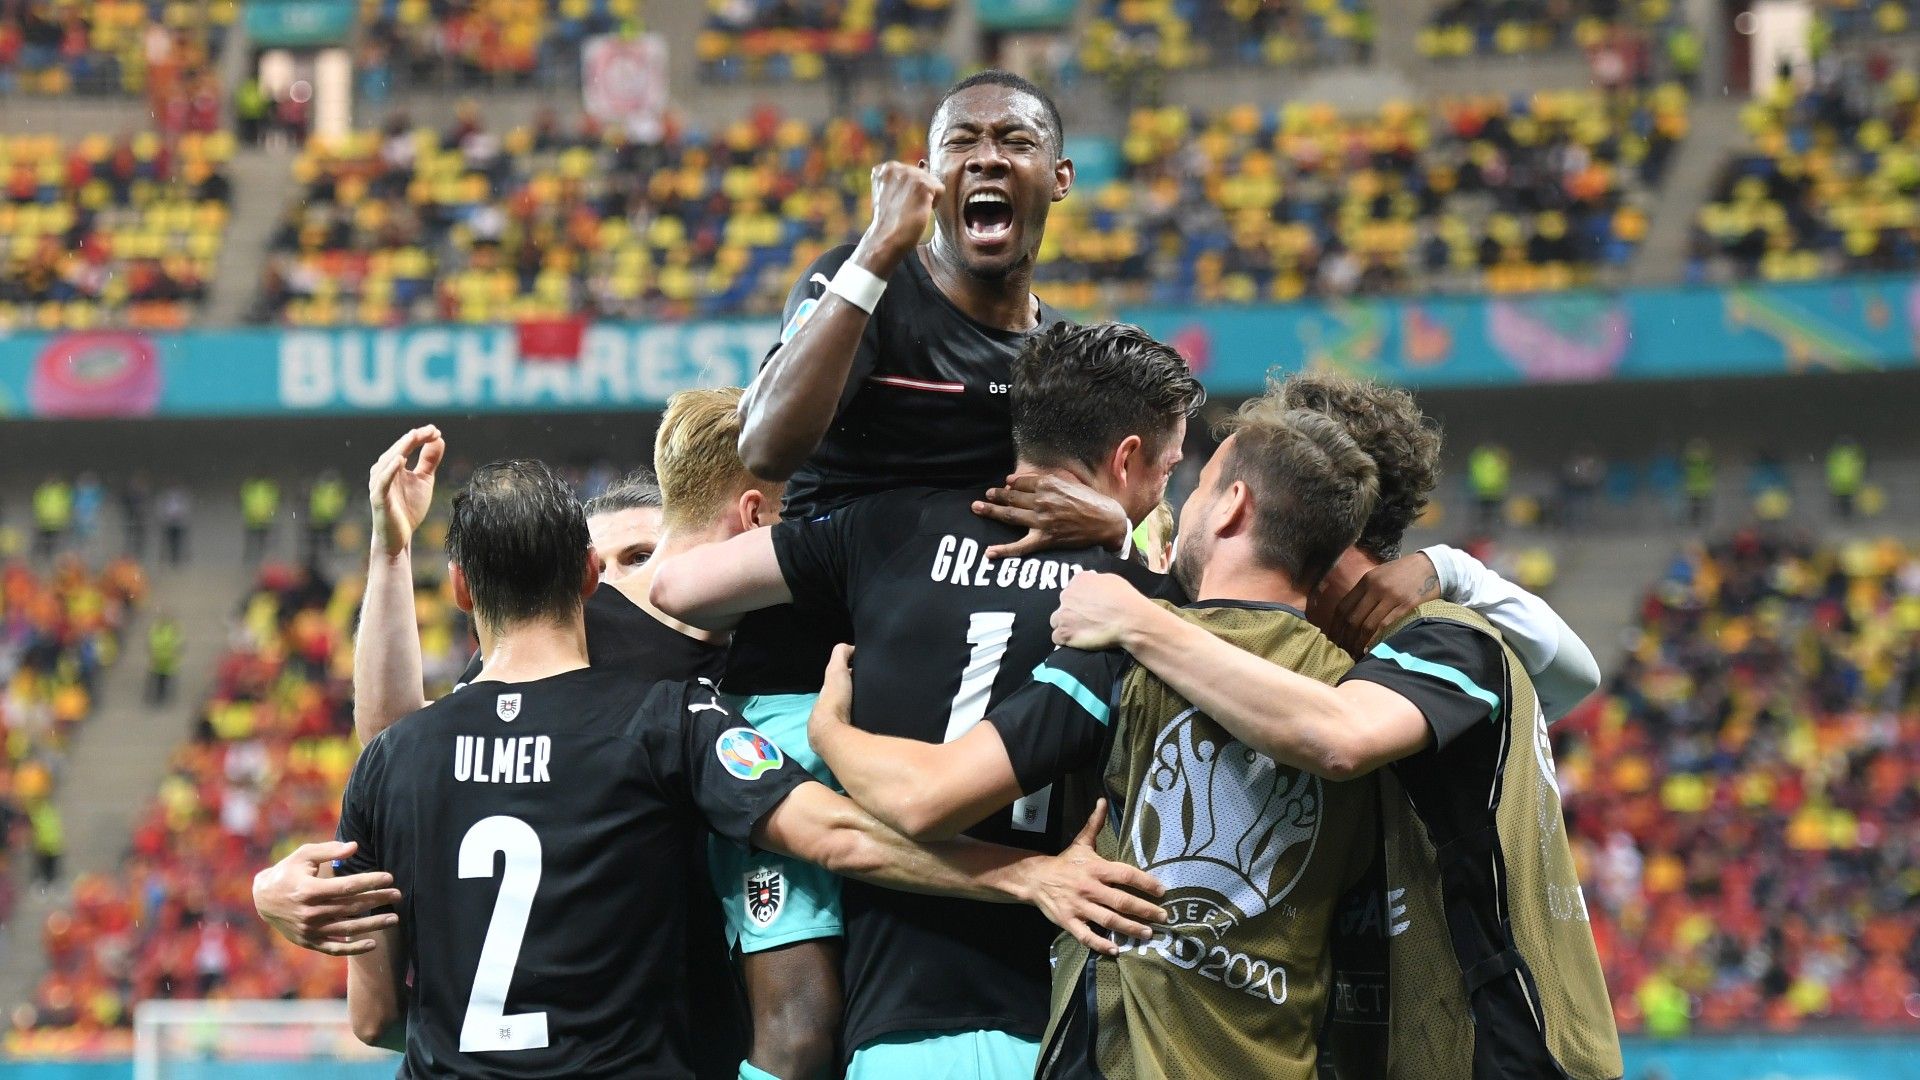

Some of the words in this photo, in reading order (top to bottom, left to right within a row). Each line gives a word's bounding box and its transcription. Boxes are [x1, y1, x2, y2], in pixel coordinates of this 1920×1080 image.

[930, 534, 1088, 591] GREGORI
[454, 735, 552, 784] ULMER
[457, 815, 550, 1053] 2
[1335, 982, 1385, 1014] PECT
